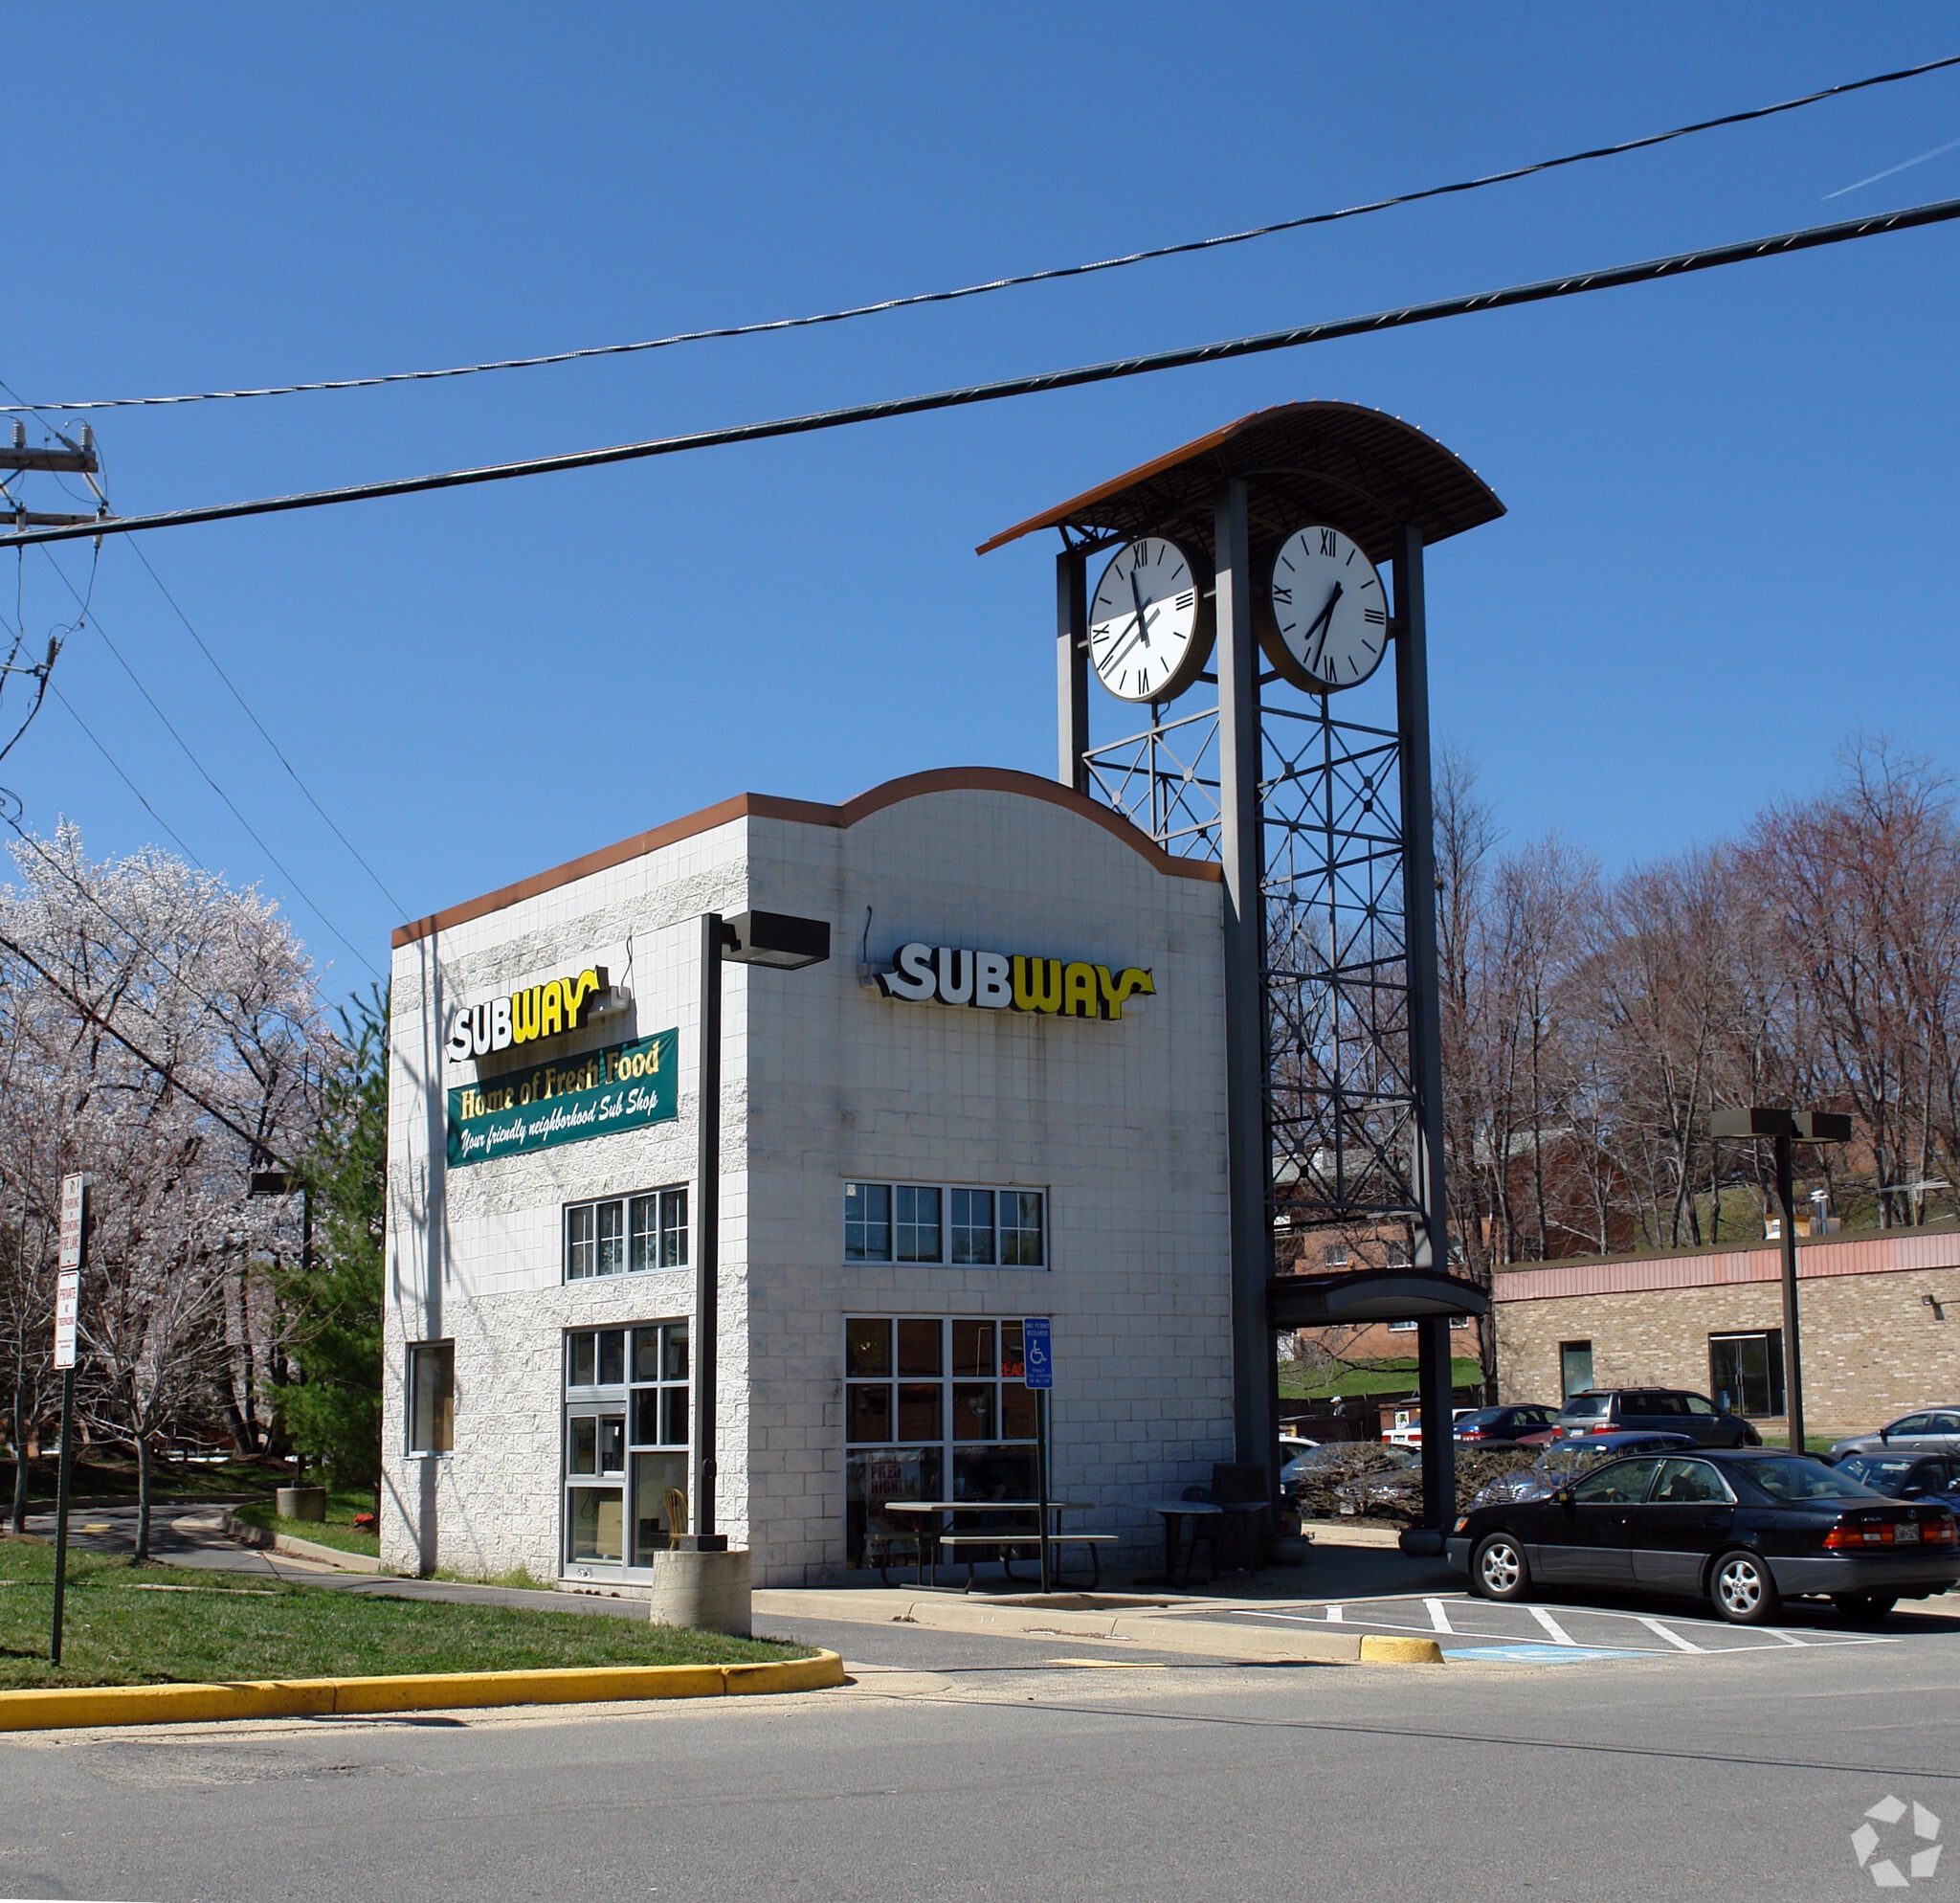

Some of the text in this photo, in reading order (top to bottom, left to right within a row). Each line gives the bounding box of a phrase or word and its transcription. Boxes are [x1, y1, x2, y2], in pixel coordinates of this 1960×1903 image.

[1133, 540, 1147, 571] XII
[1320, 528, 1336, 557] XII
[1175, 592, 1193, 611] III
[1365, 609, 1384, 625] III
[874, 942, 1156, 1020] SUBWAY
[444, 968, 601, 1063] SUBWAY
[460, 1040, 659, 1121] Home of Fresh Food
[460, 1086, 658, 1157] Your friendly neighborhood Sub Shop
